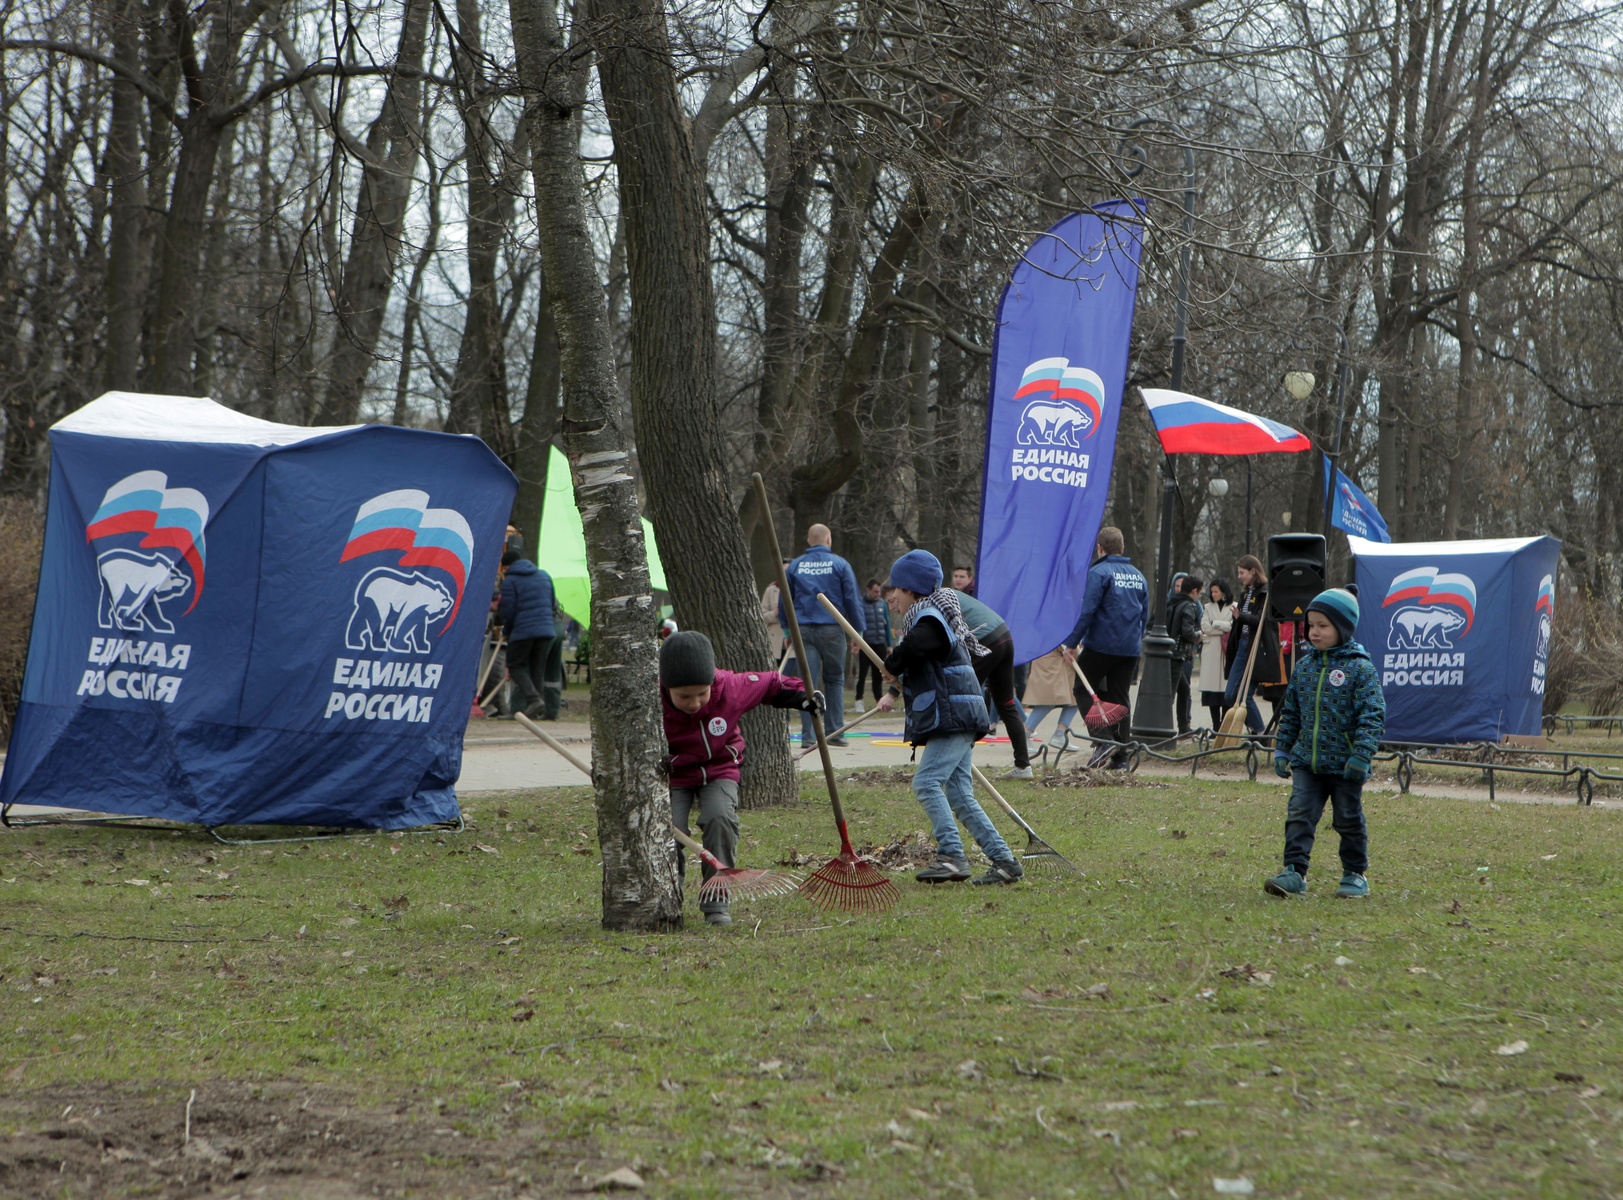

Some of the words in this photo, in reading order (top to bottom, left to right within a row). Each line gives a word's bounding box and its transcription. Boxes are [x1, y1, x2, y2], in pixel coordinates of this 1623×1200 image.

[1012, 449, 1090, 469] ЕДИНАЯ
[1011, 465, 1088, 488] РОССИЯ
[798, 567, 833, 575] РОССИЯ
[88, 637, 191, 670] ЕДИНАЯ
[1383, 652, 1465, 669] ЕДИНАЯ
[333, 657, 443, 689] ЕДИНАЯ
[1382, 670, 1464, 686] РОССИЯ
[76, 669, 183, 703] РОССИЯ
[324, 692, 434, 723] РОССИЯ
